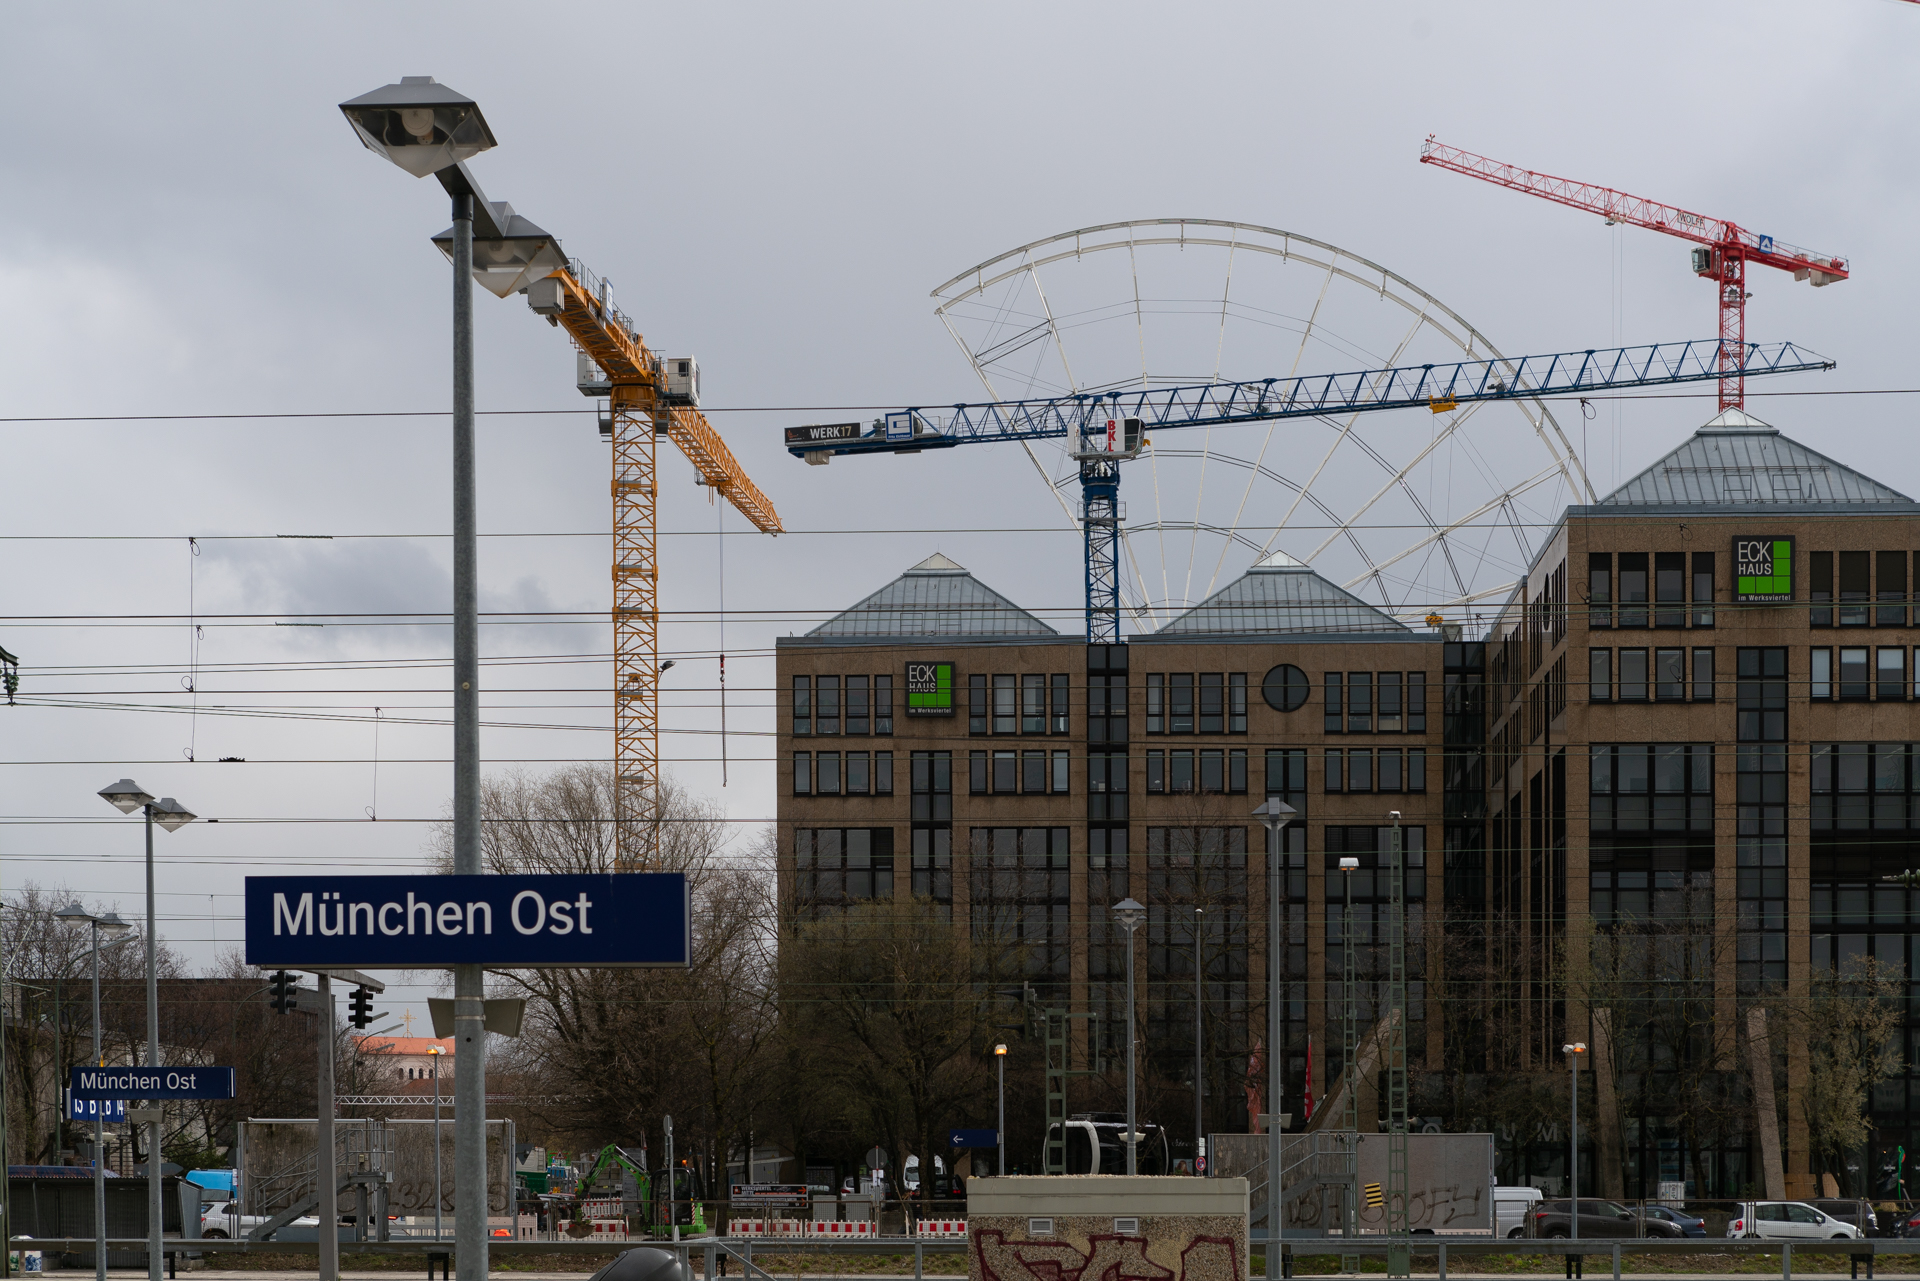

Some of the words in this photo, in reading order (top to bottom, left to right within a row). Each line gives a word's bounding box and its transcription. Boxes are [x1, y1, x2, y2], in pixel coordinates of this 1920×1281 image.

[1108, 420, 1116, 452] BKL
[1738, 541, 1771, 562] ECK
[1738, 563, 1771, 575] HAUS
[909, 665, 936, 682] ECK
[909, 682, 936, 692] HAUS
[272, 891, 492, 936] München
[511, 889, 593, 935] Ost
[81, 1072, 160, 1089] München
[166, 1072, 197, 1090] Ost
